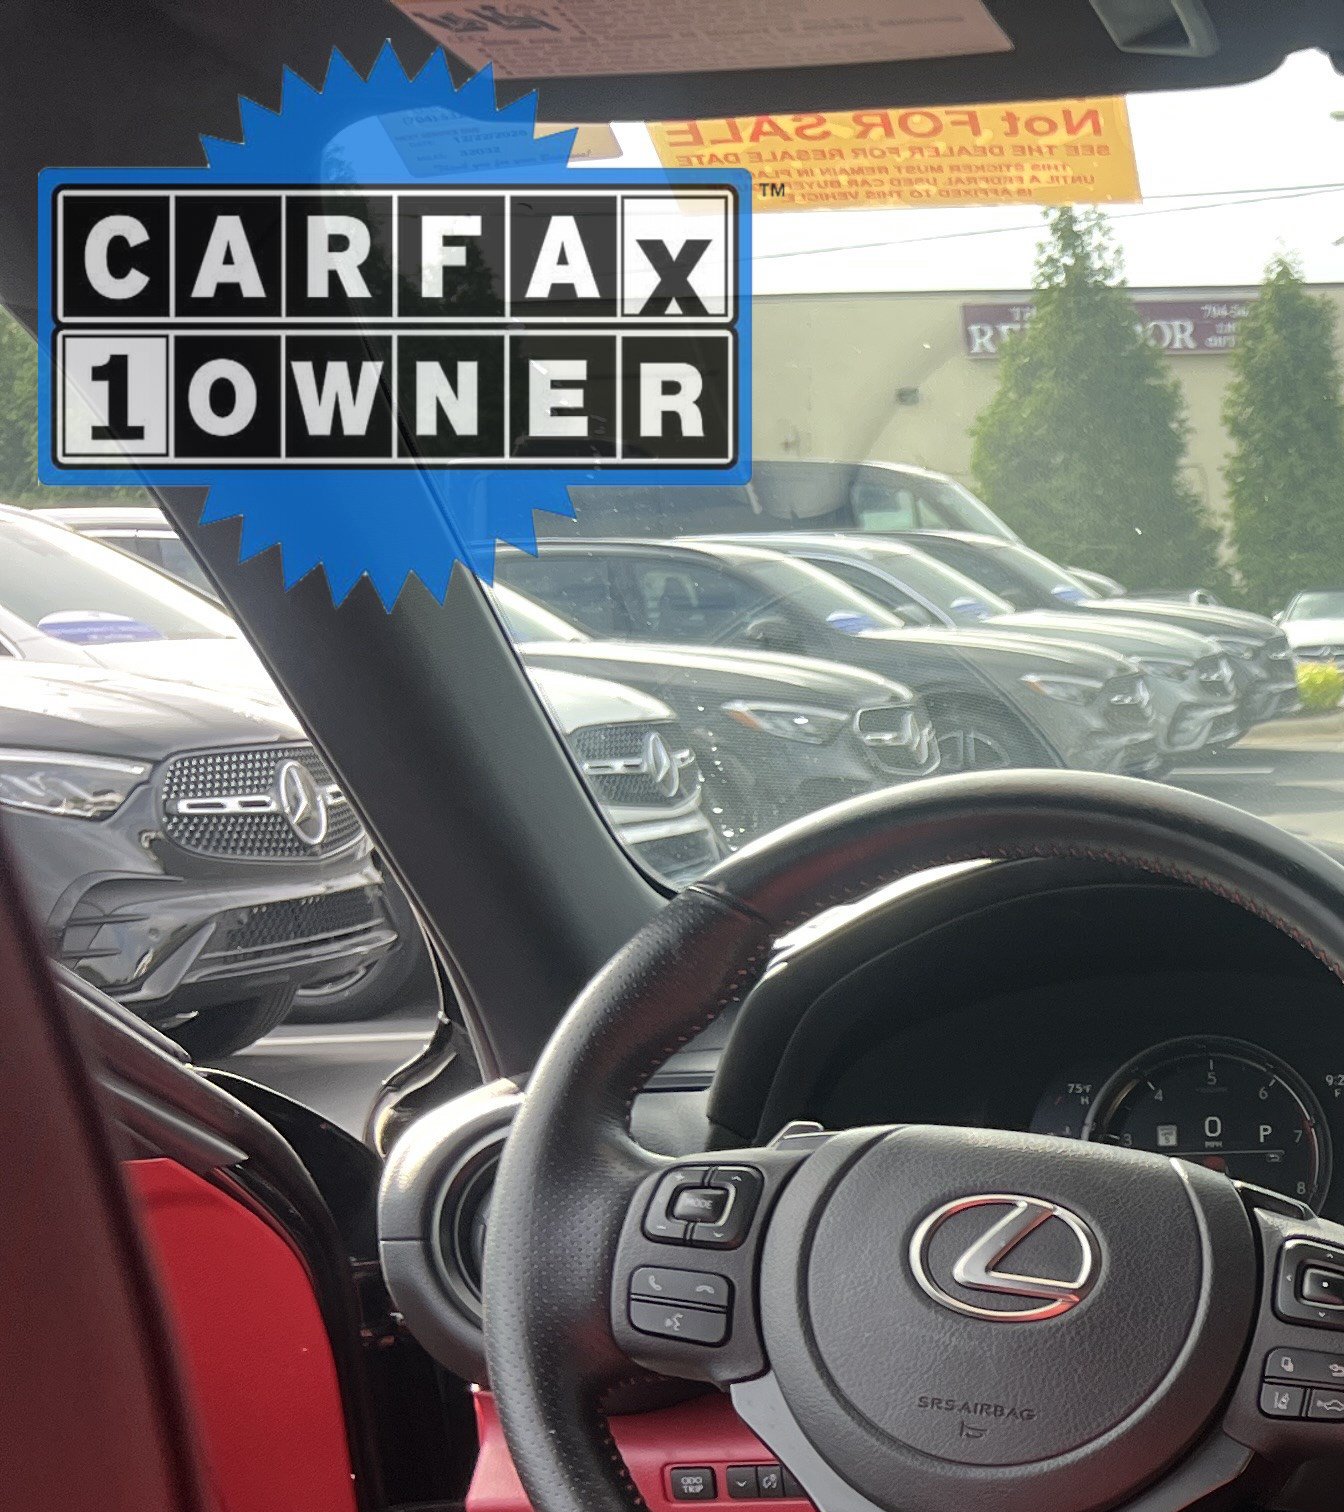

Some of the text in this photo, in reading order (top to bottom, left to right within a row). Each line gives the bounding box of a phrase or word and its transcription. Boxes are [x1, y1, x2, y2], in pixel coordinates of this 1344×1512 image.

[1206, 1071, 1217, 1085] 5
[1258, 1086, 1268, 1100] 6
[1259, 1124, 1273, 1143] P
[917, 1395, 1037, 1422] SRS AIRBAG
